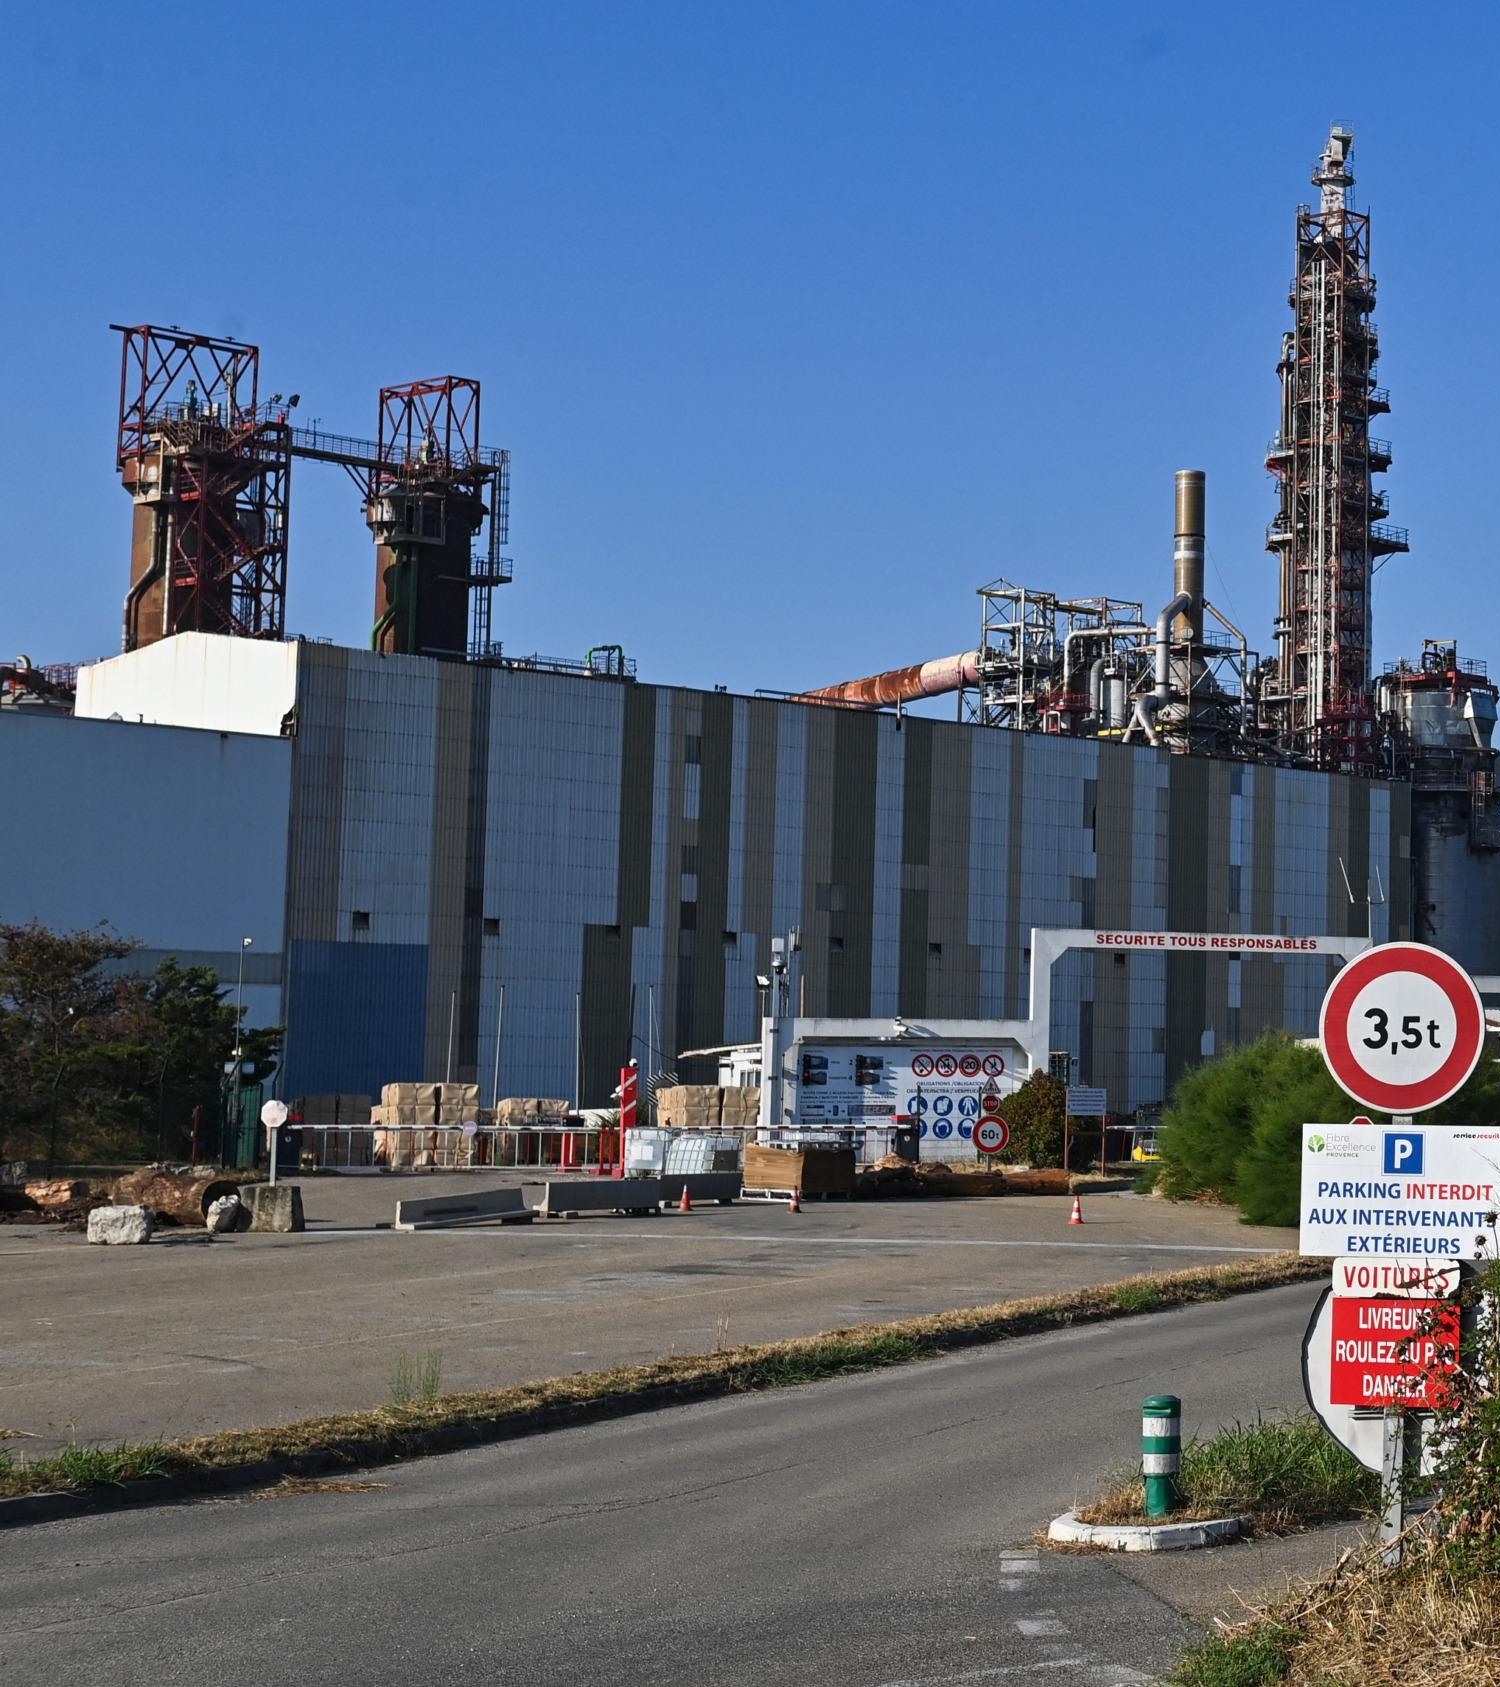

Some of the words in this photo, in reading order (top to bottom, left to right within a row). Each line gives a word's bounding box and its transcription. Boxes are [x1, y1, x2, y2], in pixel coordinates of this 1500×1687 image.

[1096, 934, 1165, 946] SECURITE
[1170, 936, 1206, 947] TOUS
[1211, 937, 1317, 949] RESPONSABLES
[1363, 1008, 1440, 1055] 3,5t
[965, 1061, 976, 1069] 20
[981, 1129, 999, 1140] 60t
[1326, 1133, 1350, 1143] Fibre
[1326, 1143, 1377, 1152] Excellence
[1394, 1139, 1413, 1169] P
[1318, 1181, 1400, 1199] PARKING
[1406, 1184, 1494, 1200] INTERDIT
[1308, 1208, 1348, 1224] AUX
[1347, 1233, 1461, 1254] EXTÉRIEURS
[1343, 1265, 1449, 1291] VOITURES
[1335, 1340, 1396, 1363] ROULEZ
